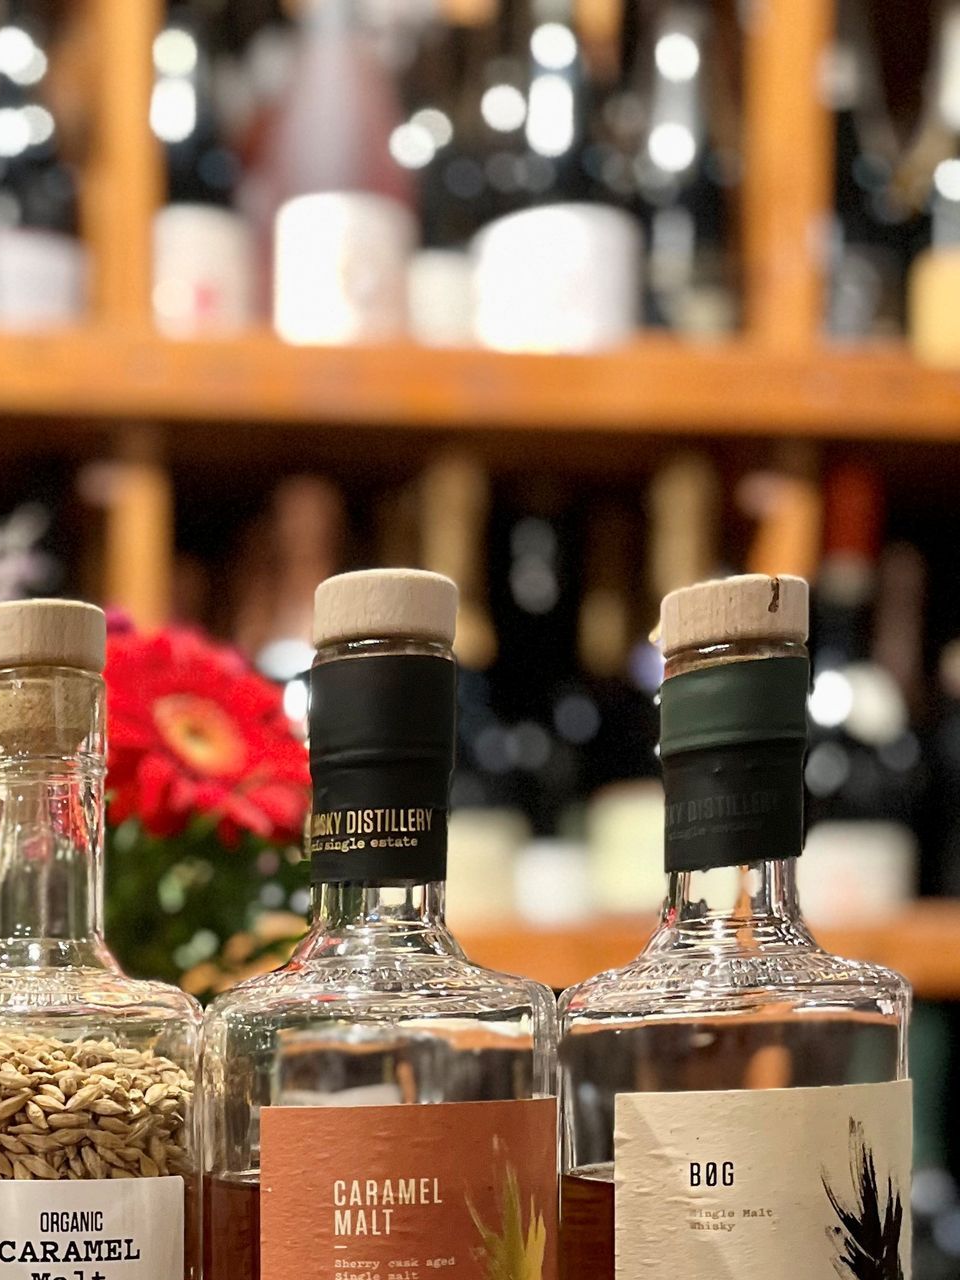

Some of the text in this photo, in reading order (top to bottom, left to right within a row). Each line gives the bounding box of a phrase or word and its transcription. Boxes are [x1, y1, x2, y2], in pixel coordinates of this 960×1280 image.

[346, 808, 433, 834] DISTILLERY
[325, 837, 365, 853] single
[370, 836, 418, 848] estate
[333, 1178, 443, 1207] CARAMEL
[40, 1211, 104, 1233] ORGANIC
[334, 1209, 394, 1236] MALT
[742, 1208, 773, 1218] Malt
[334, 1258, 380, 1270] Sherry
[425, 1256, 456, 1269] aged
[387, 1271, 419, 1280] malt
